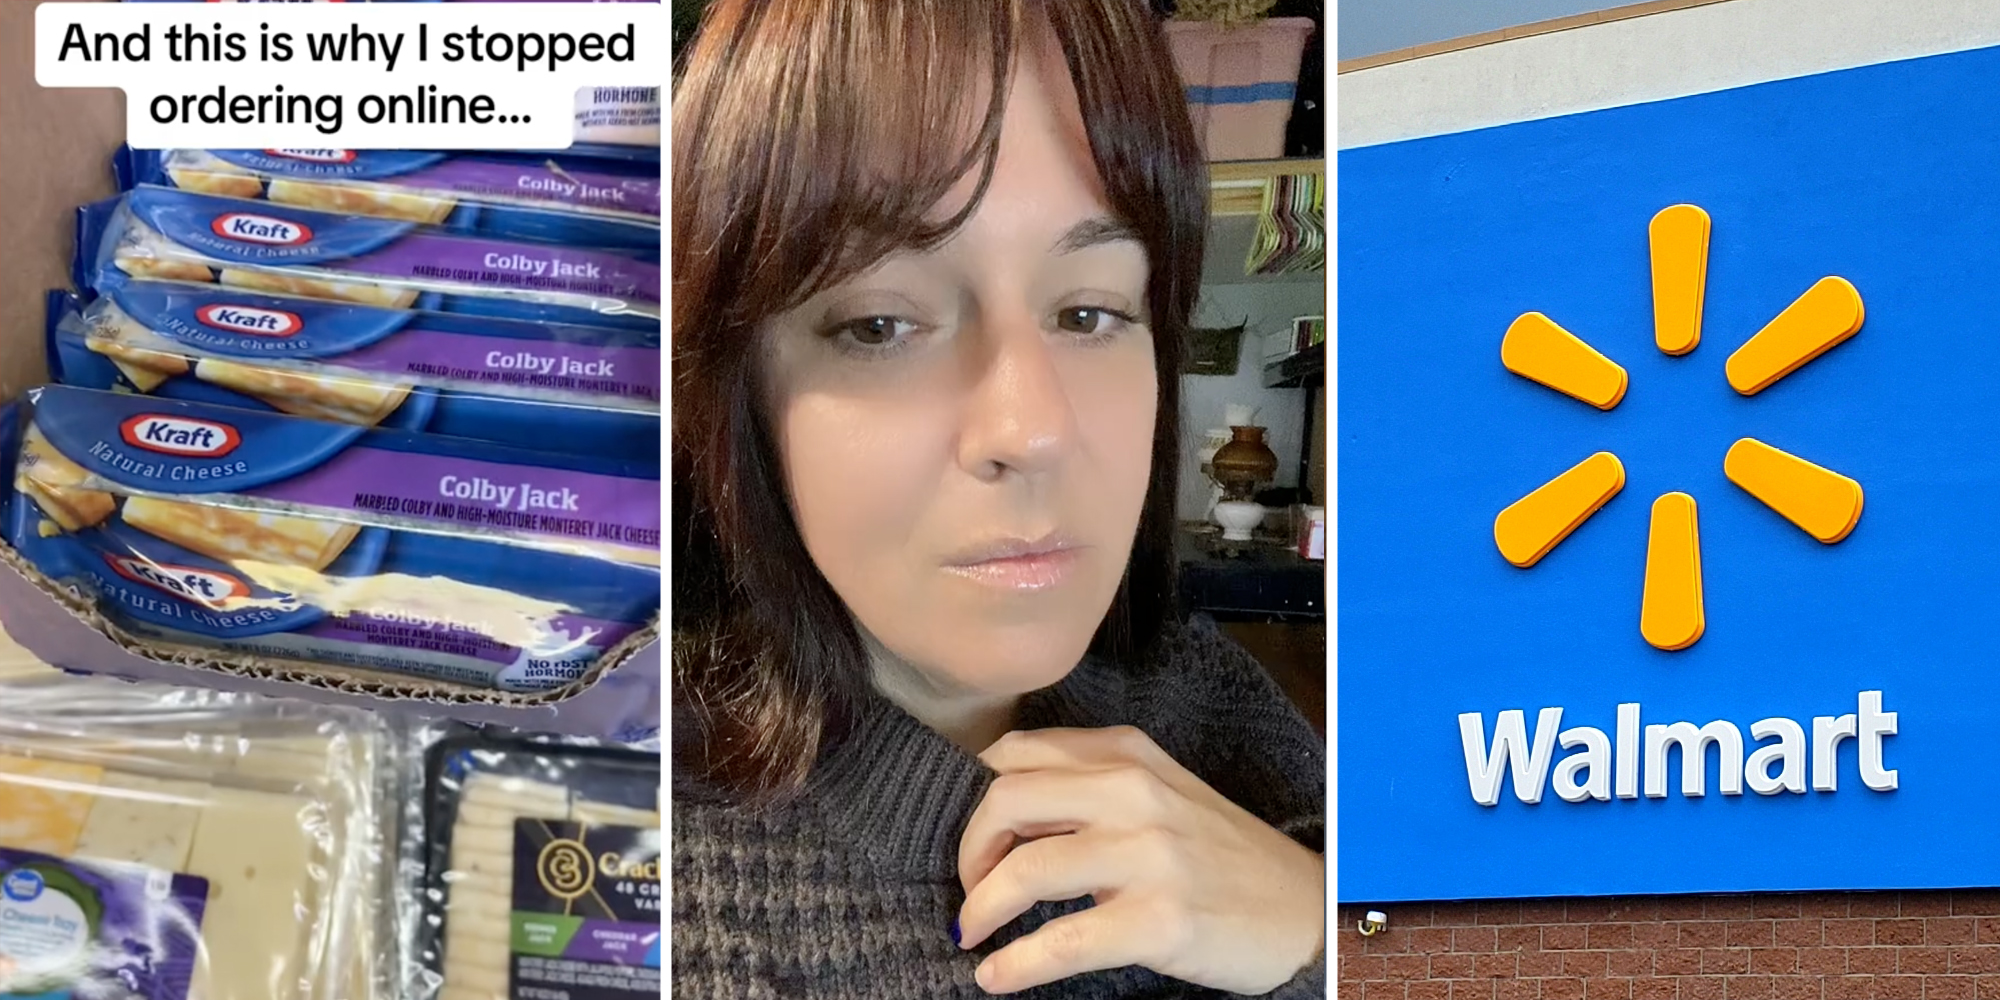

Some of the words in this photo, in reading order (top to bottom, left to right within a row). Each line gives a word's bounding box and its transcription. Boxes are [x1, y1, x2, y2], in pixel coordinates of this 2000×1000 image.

[594, 87, 657, 104] HORMONE
[518, 175, 576, 196] Colby
[233, 218, 290, 240] Kraft
[412, 265, 451, 279] MARBLED
[452, 268, 480, 281] COLBY
[480, 271, 499, 283] AND
[484, 252, 548, 277] Colby
[550, 259, 600, 279] Jack
[217, 309, 278, 330] Kraft
[167, 318, 232, 346] Natural
[240, 339, 309, 350] Cheese
[486, 351, 555, 374] Colby
[557, 356, 615, 376] Jack
[407, 362, 450, 377] MARBLED
[450, 367, 479, 380] COLBY
[479, 370, 500, 382] AND
[501, 372, 576, 389] HIGH-MOISTURE
[578, 379, 628, 395] MONTEREY
[145, 421, 214, 448] Kraft
[88, 440, 165, 479] Natural
[170, 460, 248, 481] Cheese
[440, 474, 516, 509] Colby
[517, 483, 579, 512] Jack
[353, 493, 399, 512] MARBLED
[401, 498, 433, 516] COLBY
[433, 501, 455, 519] AND
[456, 504, 538, 531] HIGH-MOISTURE
[539, 515, 595, 537] MONTEREY
[596, 522, 622, 541] JACK
[624, 525, 661, 547] CHEESE
[128, 562, 215, 598] Kraft
[91, 570, 183, 618] Natural
[190, 607, 276, 628] Cheese
[367, 634, 416, 648] MONTEREY
[418, 639, 441, 652] JACK
[443, 643, 477, 657] CHEESE
[380, 624, 411, 638] COLBY
[411, 628, 433, 640] AND
[1458, 689, 1898, 807] Walmart
